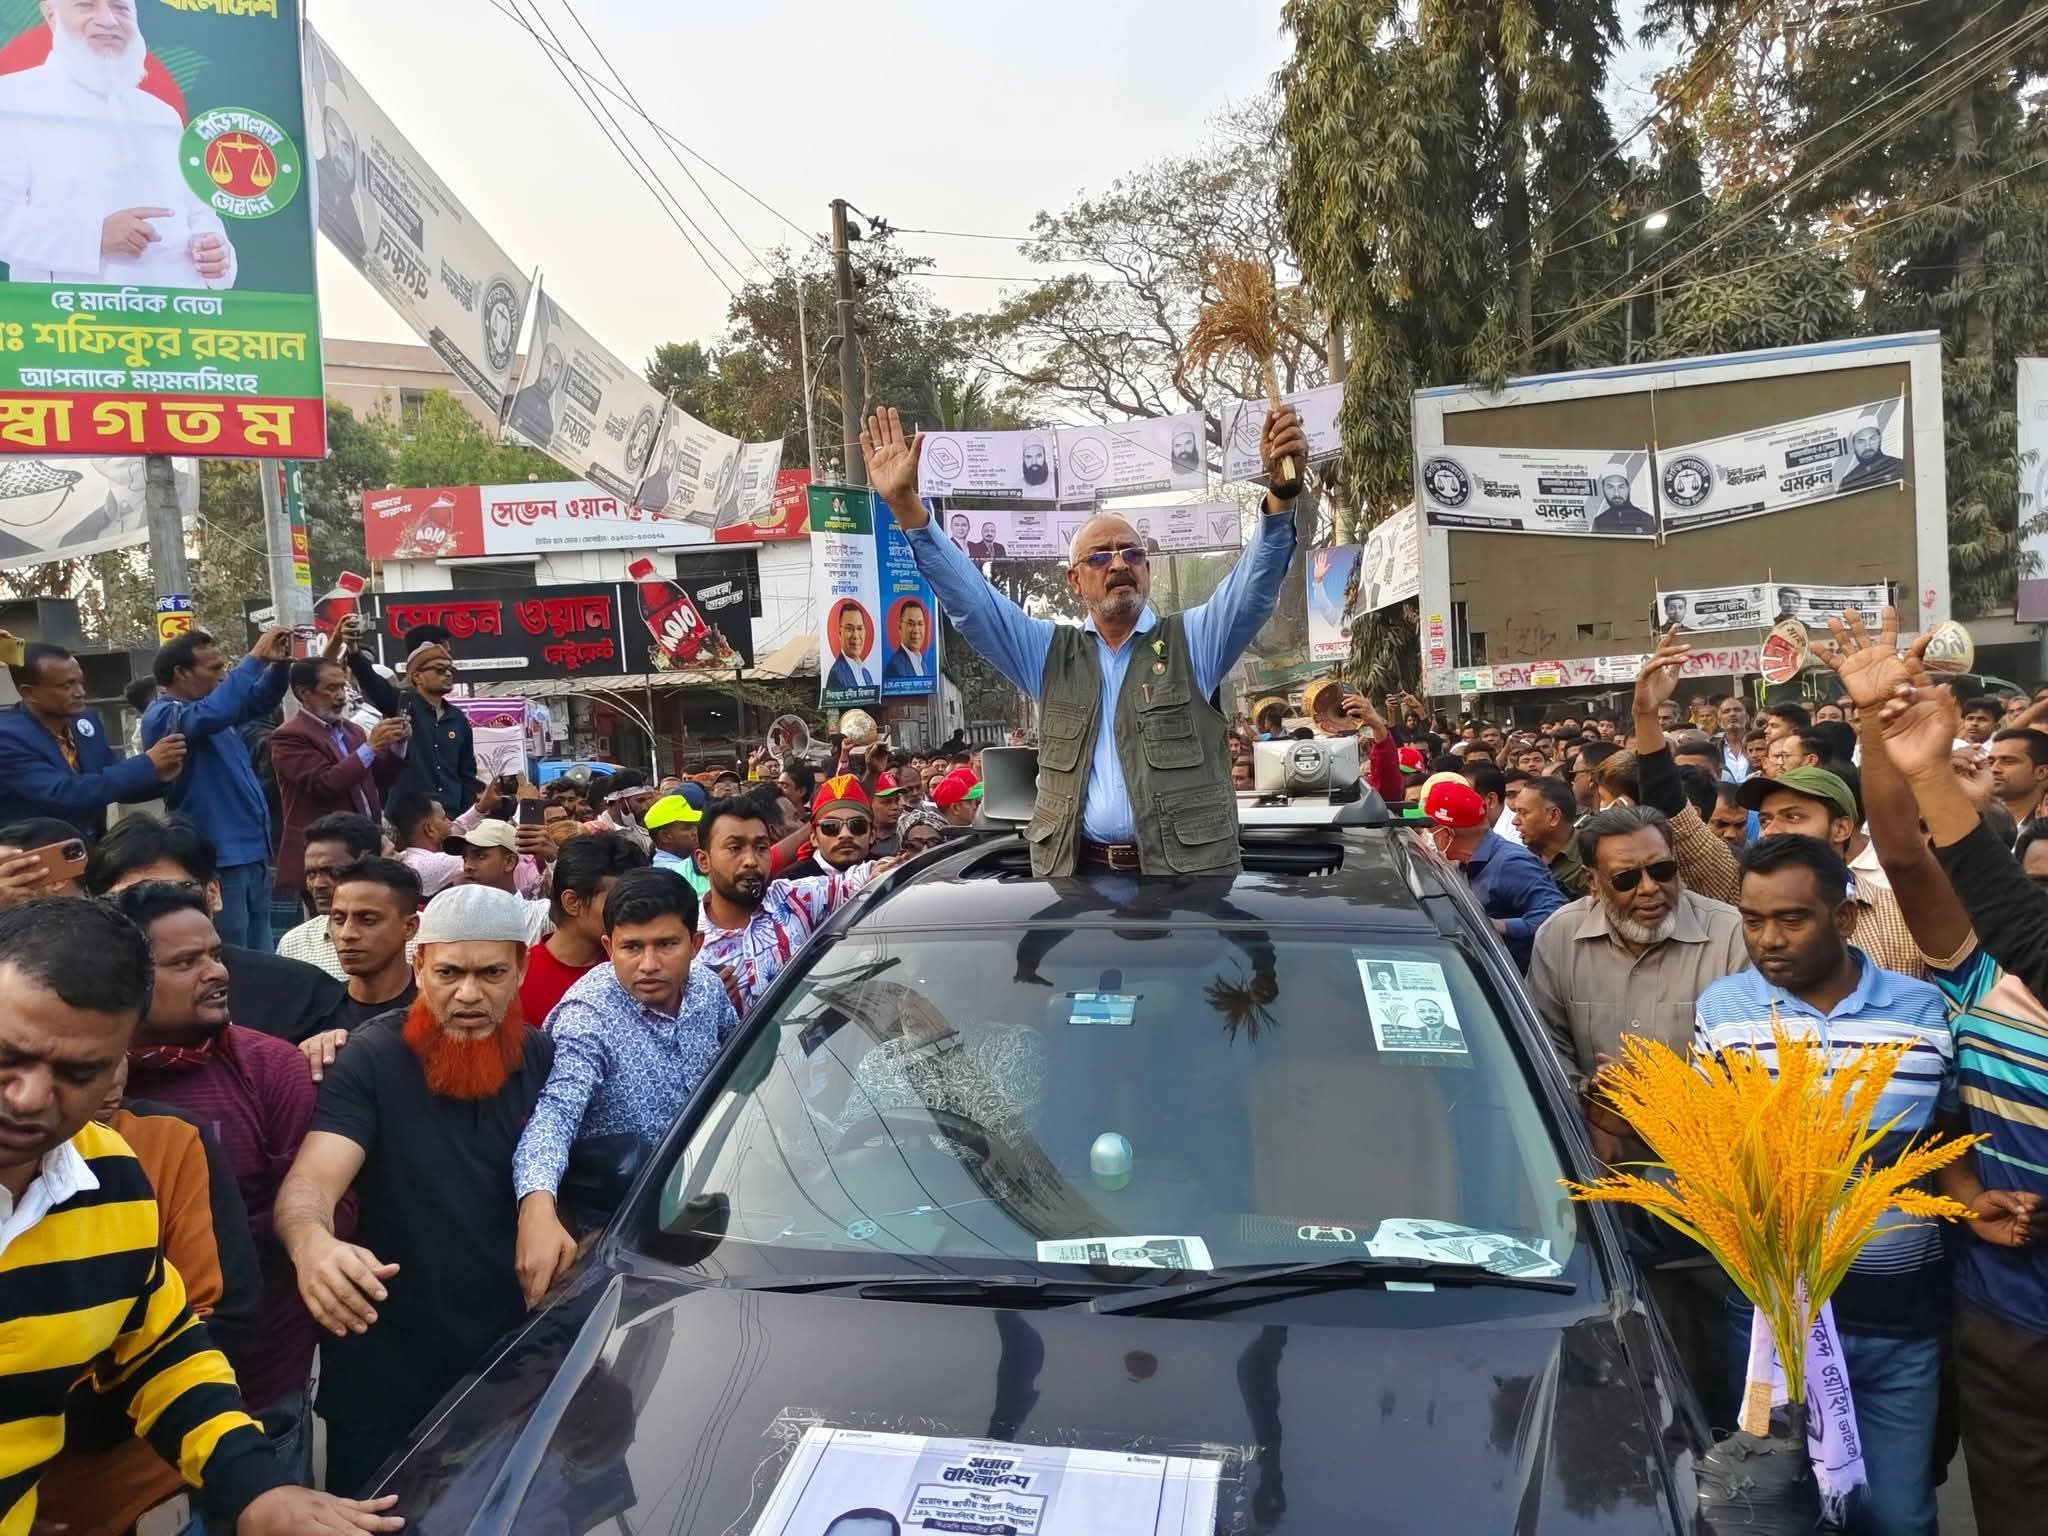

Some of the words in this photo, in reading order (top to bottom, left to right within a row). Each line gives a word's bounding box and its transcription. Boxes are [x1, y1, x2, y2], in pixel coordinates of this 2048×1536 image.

[51, 290, 75, 311] হে
[79, 288, 167, 314] মানবিক
[173, 291, 224, 316] নেতা
[33, 313, 181, 367] শফিকুর
[190, 331, 307, 361] রহমান
[19, 367, 125, 390] আপনাকে
[131, 365, 259, 395] ময়মনসিংহে
[1779, 469, 1833, 493] এমরুল
[490, 499, 558, 528] সেভেন
[565, 496, 617, 520] ওয়ান
[1535, 503, 1586, 520] এমরুল
[514, 595, 611, 638] ওয়ান
[659, 604, 698, 653] MOJO
[943, 1466, 1032, 1490] বাংলাদেশ
[968, 1456, 1015, 1471] সবার
